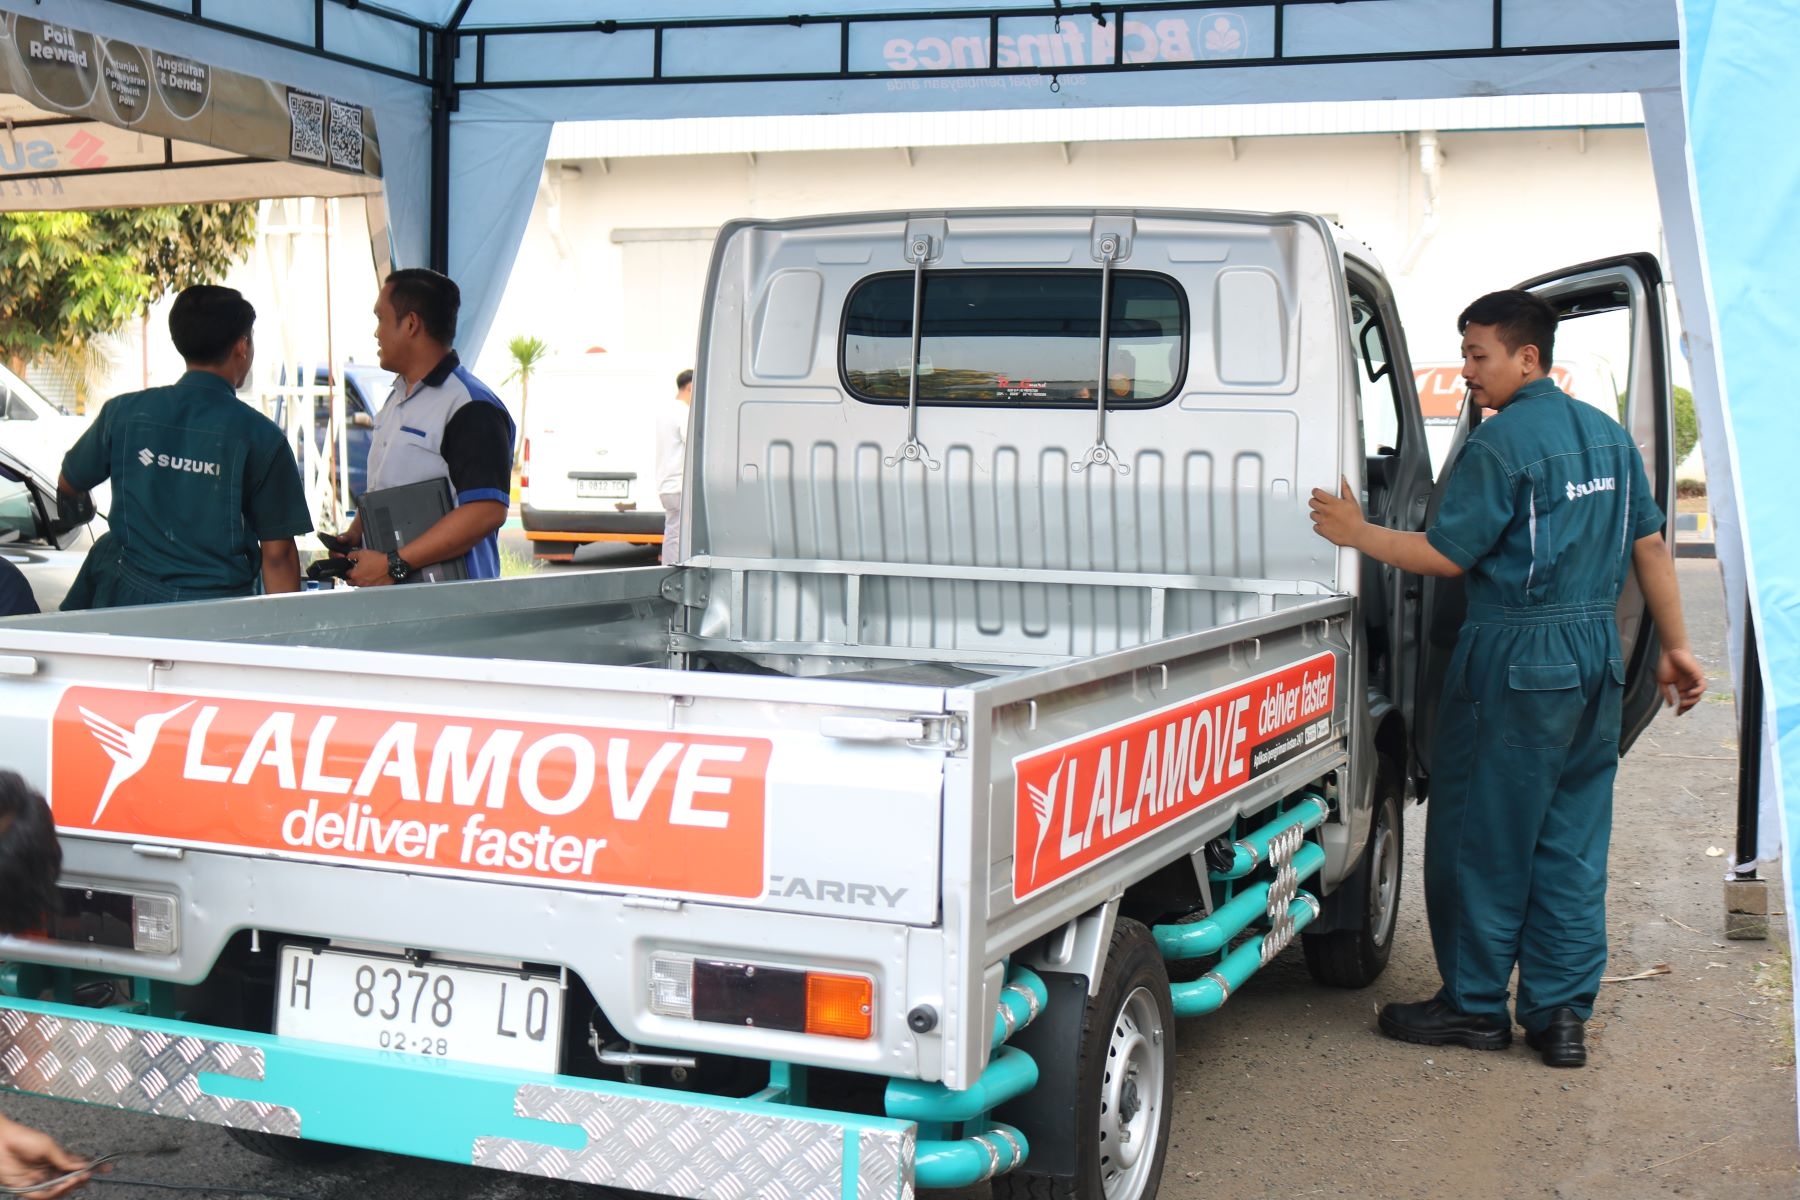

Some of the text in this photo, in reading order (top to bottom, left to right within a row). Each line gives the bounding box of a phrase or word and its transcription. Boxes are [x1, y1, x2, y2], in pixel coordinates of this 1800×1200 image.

[30, 41, 88, 68] Reward
[156, 55, 205, 79] Angsuran
[160, 73, 202, 93] & Denda
[157, 453, 220, 476] SUZUKI
[1258, 682, 1300, 736] deliver
[1301, 670, 1332, 717] faster
[183, 705, 746, 829] LALAMOVE
[1059, 695, 1250, 861] LALAMOVE
[282, 798, 607, 876] deliver faster
[290, 956, 313, 1010] H
[353, 964, 455, 1028] 8378
